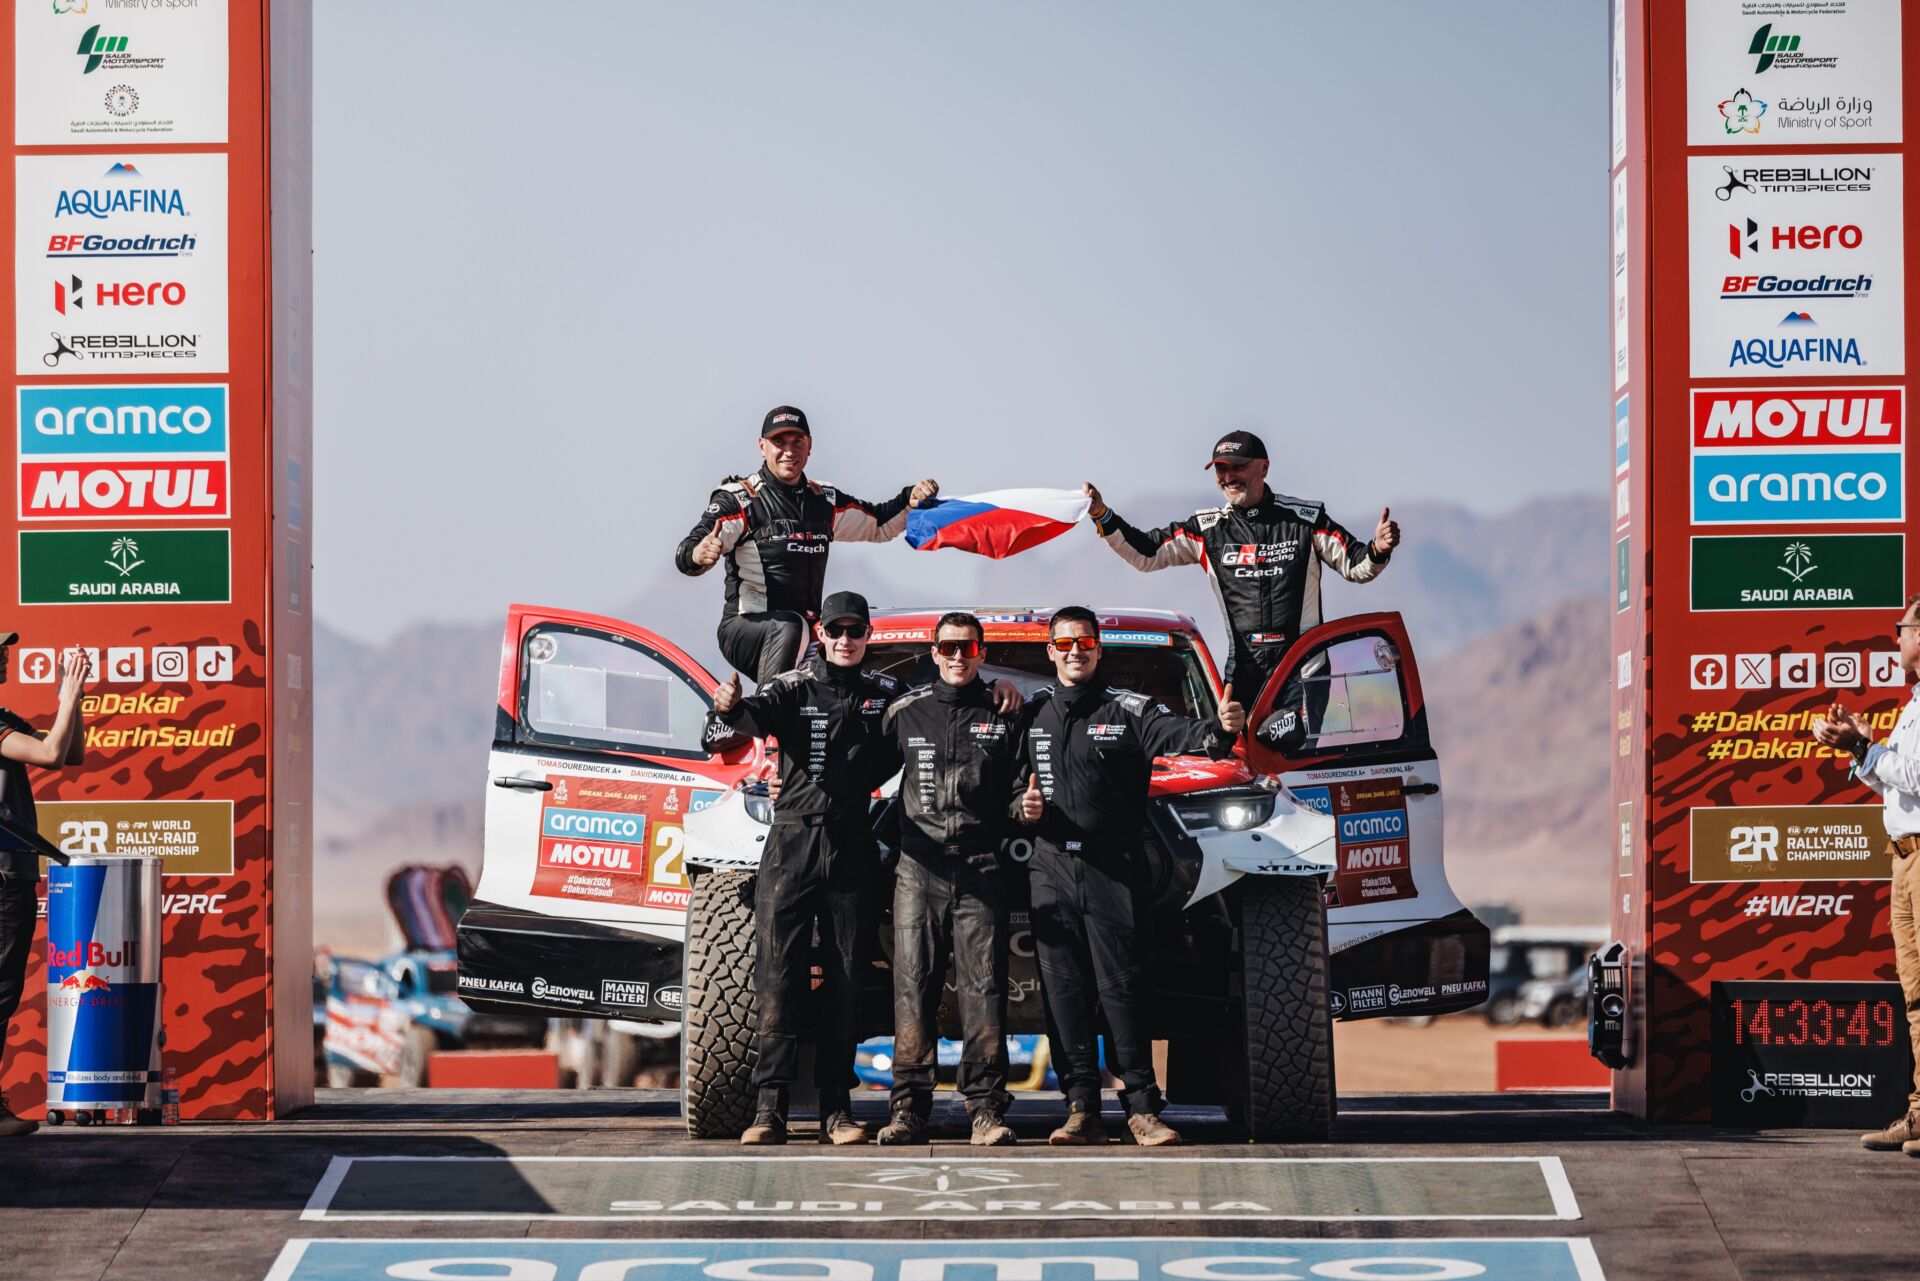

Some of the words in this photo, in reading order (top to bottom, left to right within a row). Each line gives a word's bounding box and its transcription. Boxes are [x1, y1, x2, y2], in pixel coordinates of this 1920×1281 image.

[1778, 97, 1830, 114] الرياضة
[1836, 96, 1872, 114] وزارة
[1778, 116, 1822, 130] Ministry
[1824, 116, 1837, 128] of
[1840, 116, 1872, 130] Sport
[54, 189, 185, 219] AQUAFINA
[48, 234, 196, 252] BFGoodrich
[1772, 225, 1862, 250] Hero
[1722, 275, 1872, 292] BFGoodrich
[96, 282, 186, 306] Hero
[1730, 338, 1862, 368] AQUAFINA
[35, 405, 212, 435] aramco
[1704, 398, 1892, 438] MOTUL
[30, 469, 218, 508] MOTUL
[1708, 472, 1887, 502] aramco
[1201, 516, 1216, 524] OMP
[1300, 508, 1316, 518] OMP
[786, 542, 824, 554] Czech
[1258, 547, 1296, 556] GAZOO
[1260, 540, 1299, 550] TOYOTA
[1222, 552, 1256, 564] GR
[1256, 554, 1295, 564] Racing
[1234, 566, 1283, 578] Czech
[69, 583, 116, 596] SAUDI
[120, 582, 181, 594] ARABIA
[1740, 589, 1788, 602] SAUDI
[1793, 588, 1854, 600] ARABIA
[870, 632, 926, 640] MOTUL
[1105, 633, 1165, 642] aramco
[81, 692, 185, 717] @Dakar
[630, 770, 680, 782] DAVIDKRIPAL
[680, 774, 696, 782] AB+
[1370, 766, 1404, 775] DAVIDKRIPAL
[579, 790, 603, 798] DREAM.
[604, 791, 623, 799] DARE.
[1305, 797, 1328, 808] mco
[152, 820, 191, 830] WORLD
[551, 814, 638, 836] aramco
[1344, 816, 1402, 836] aramco
[1787, 826, 1800, 835] FIA
[1823, 825, 1862, 835] WORLD
[116, 832, 197, 844] RALLY-RAID
[1787, 836, 1868, 850] RALLY-RAID
[116, 846, 200, 856] CHAMPIONSHIP
[550, 844, 632, 870] MOTUL
[1347, 844, 1401, 870] MOTUL
[1787, 851, 1870, 862] CHAMPIONSHIP
[1257, 864, 1334, 872] XTLINE
[568, 875, 611, 887] #Dakar2024
[561, 884, 614, 898] #DakarInSaudi
[648, 890, 690, 905] MOTU
[1744, 894, 1854, 917] #W2RC
[48, 940, 82, 967] Red
[88, 940, 136, 968] Bull
[458, 976, 487, 988] PNEU
[489, 980, 524, 992] KAFKA
[532, 978, 596, 1000] GLENOWELL
[605, 983, 646, 994] MANN
[1441, 983, 1462, 994] PNEU
[1463, 980, 1486, 992] KAFKA
[604, 992, 645, 1004] FILTER
[1351, 988, 1382, 1000] MANN
[1388, 984, 1436, 1005] GLENOWELL
[1352, 997, 1384, 1009] FILTER
[1731, 1000, 1894, 1046] 14:33:49
[94, 1072, 110, 1083] body
[608, 1200, 882, 1212] SAUDI
[912, 1200, 1272, 1212] ARABIA
[384, 1255, 1487, 1281] aramco
